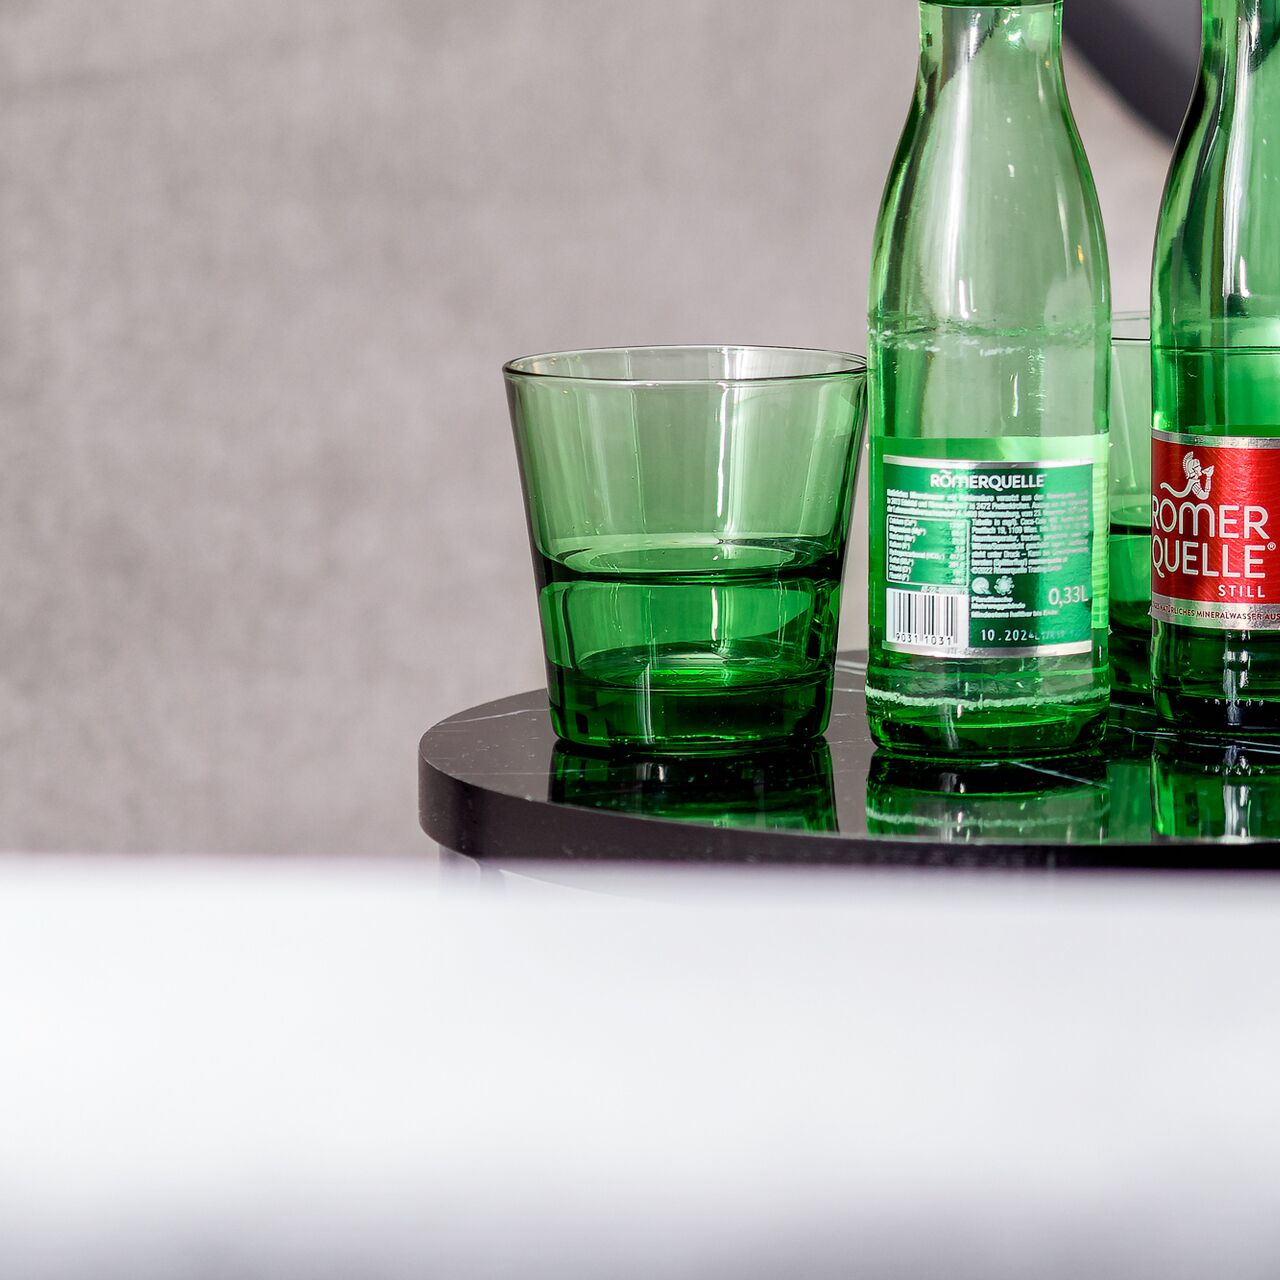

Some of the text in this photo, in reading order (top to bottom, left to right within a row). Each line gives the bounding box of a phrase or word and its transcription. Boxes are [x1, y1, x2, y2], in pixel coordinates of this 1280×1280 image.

[1048, 585, 1089, 608] 0,33L
[1218, 584, 1266, 598] STILL
[1196, 610, 1263, 620] MINERALWASSER
[1265, 612, 1280, 620] AUS
[895, 632, 952, 646] 9031 1031
